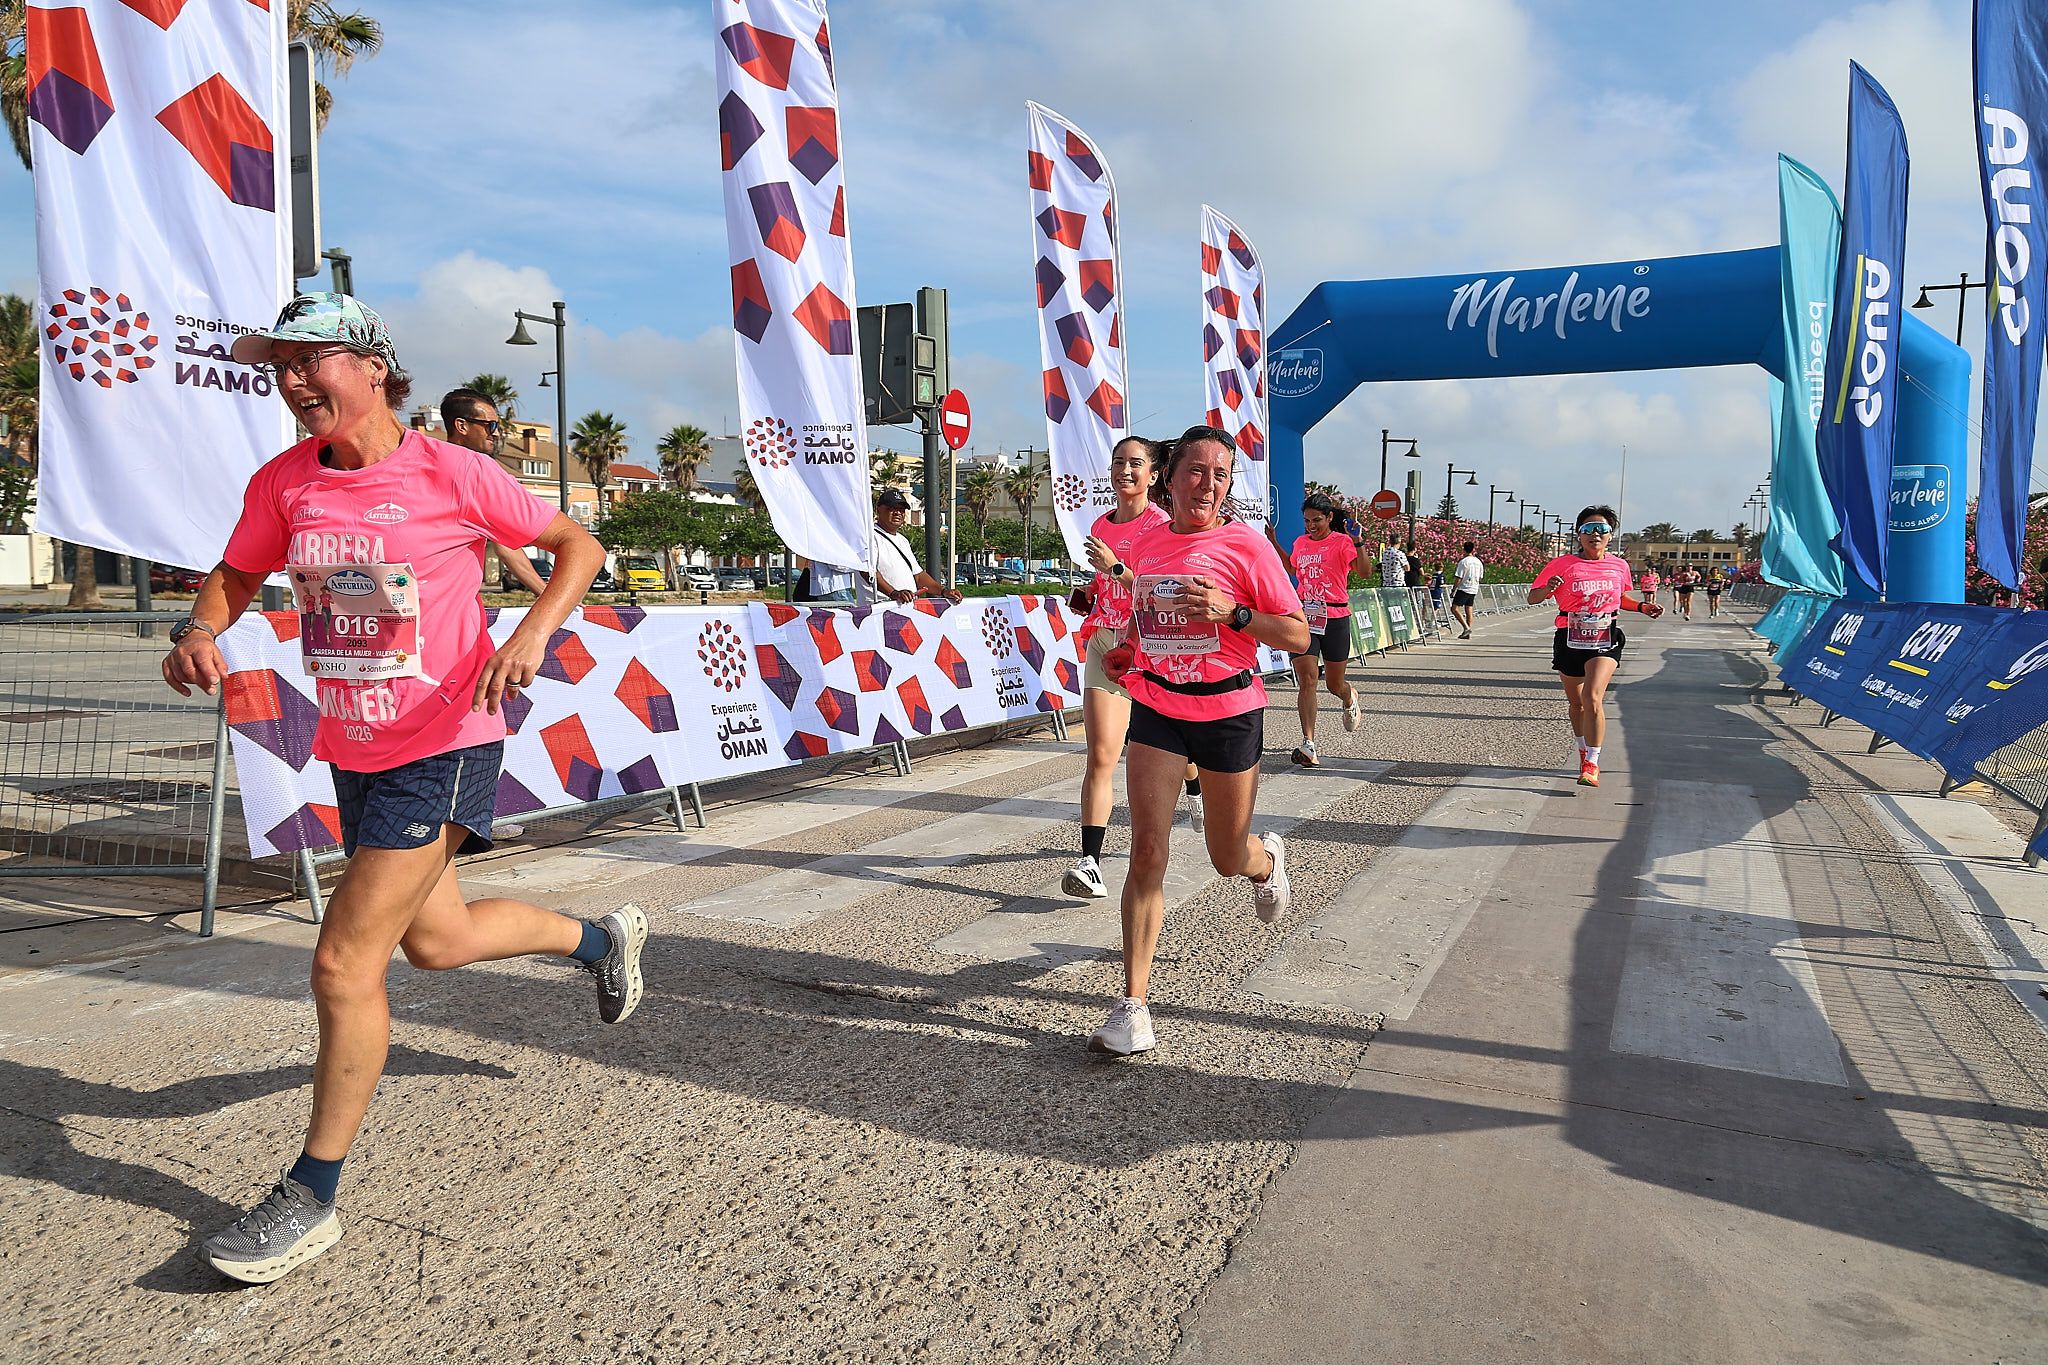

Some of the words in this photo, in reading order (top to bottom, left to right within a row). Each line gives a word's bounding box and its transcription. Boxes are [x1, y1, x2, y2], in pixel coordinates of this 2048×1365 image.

[1446, 272, 1650, 358] Marlene
[1267, 359, 1319, 385] Marlene
[1890, 479, 1945, 507] arlene
[1918, 512, 1940, 526] ALPES
[289, 532, 386, 566] ARRERA
[331, 580, 374, 591] ASTURIANA
[1572, 580, 1614, 593] CARRERA
[334, 615, 379, 636] 016
[1157, 611, 1188, 626] 016
[1829, 612, 1865, 646] GOYA
[346, 639, 368, 648] 2093
[1900, 621, 1963, 663] GOYA
[311, 648, 336, 656] CARRERA
[318, 662, 346, 672] YSHO
[366, 663, 405, 673] Santander
[991, 666, 1021, 677] Experience
[998, 692, 1029, 709] OMAN
[711, 702, 758, 717] Experience
[343, 725, 374, 742] 2026
[721, 737, 768, 760] OMAN
